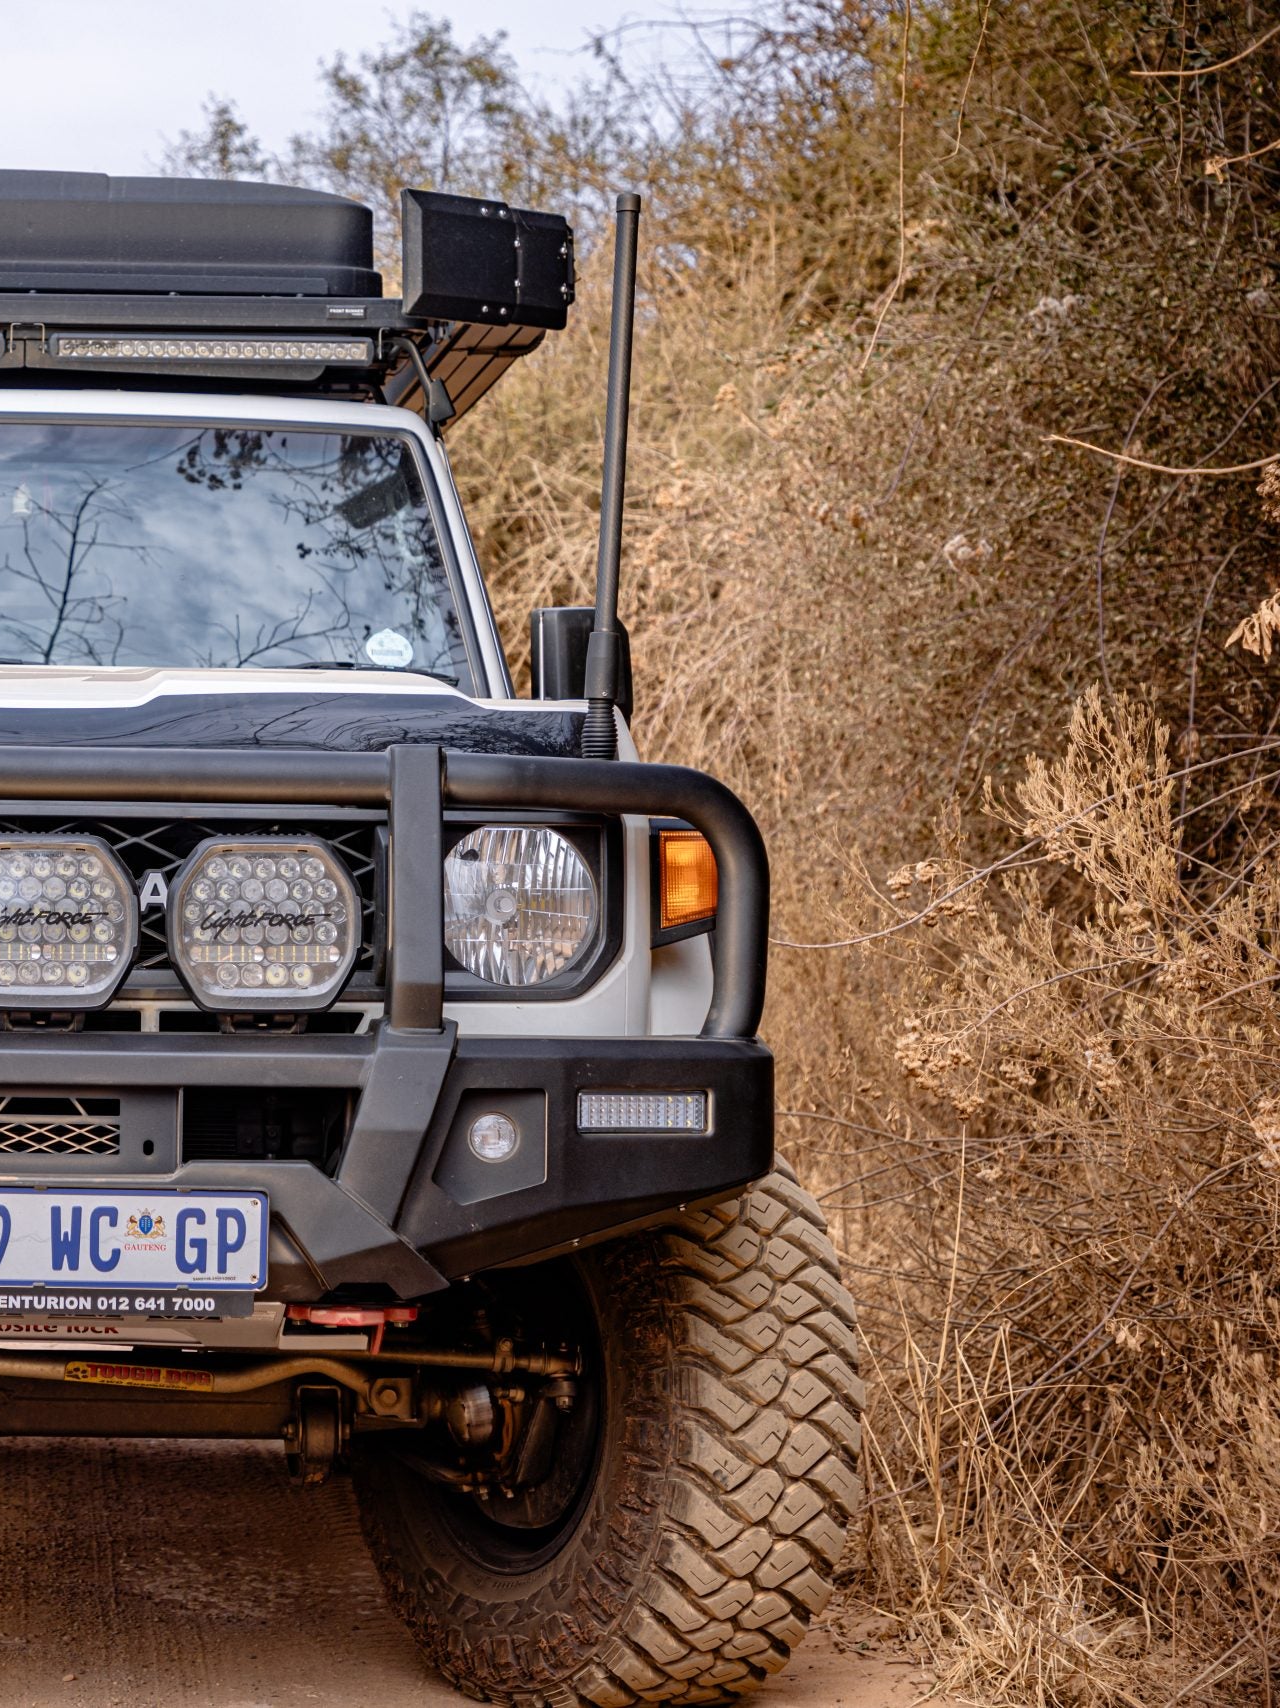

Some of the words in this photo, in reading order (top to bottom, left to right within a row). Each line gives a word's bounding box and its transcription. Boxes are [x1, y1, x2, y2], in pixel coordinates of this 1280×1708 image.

[51, 1206, 121, 1273] WC
[175, 1207, 247, 1274] GP
[124, 1243, 167, 1252] GAUTENG
[97, 1297, 129, 1311] 012
[134, 1297, 165, 1311] 641
[172, 1298, 216, 1312] 7000
[86, 1363, 161, 1382] TOUGH
[165, 1369, 211, 1386] DOG
